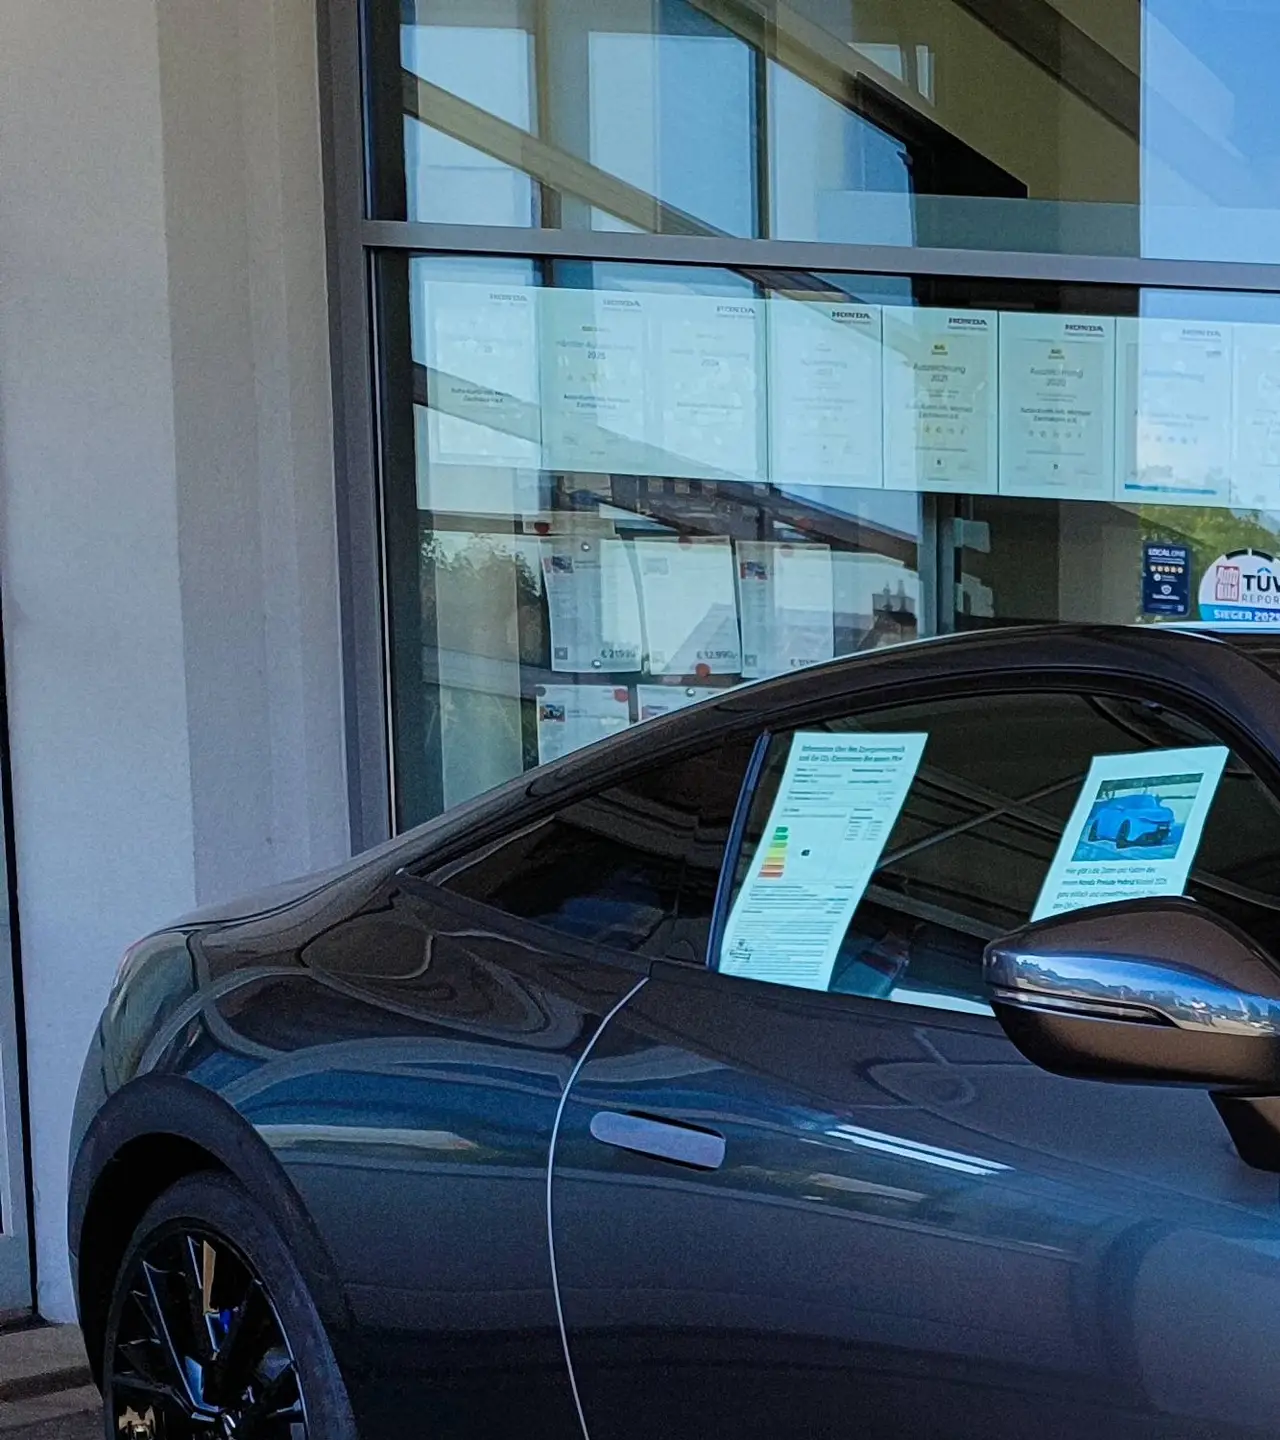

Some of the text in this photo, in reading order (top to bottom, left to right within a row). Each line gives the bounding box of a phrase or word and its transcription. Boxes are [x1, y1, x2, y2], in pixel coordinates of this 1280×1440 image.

[831, 311, 871, 319] HONDA
[948, 317, 987, 326] HONDA
[1064, 323, 1104, 332] HONDA
[1213, 610, 1252, 620] SIEGER
